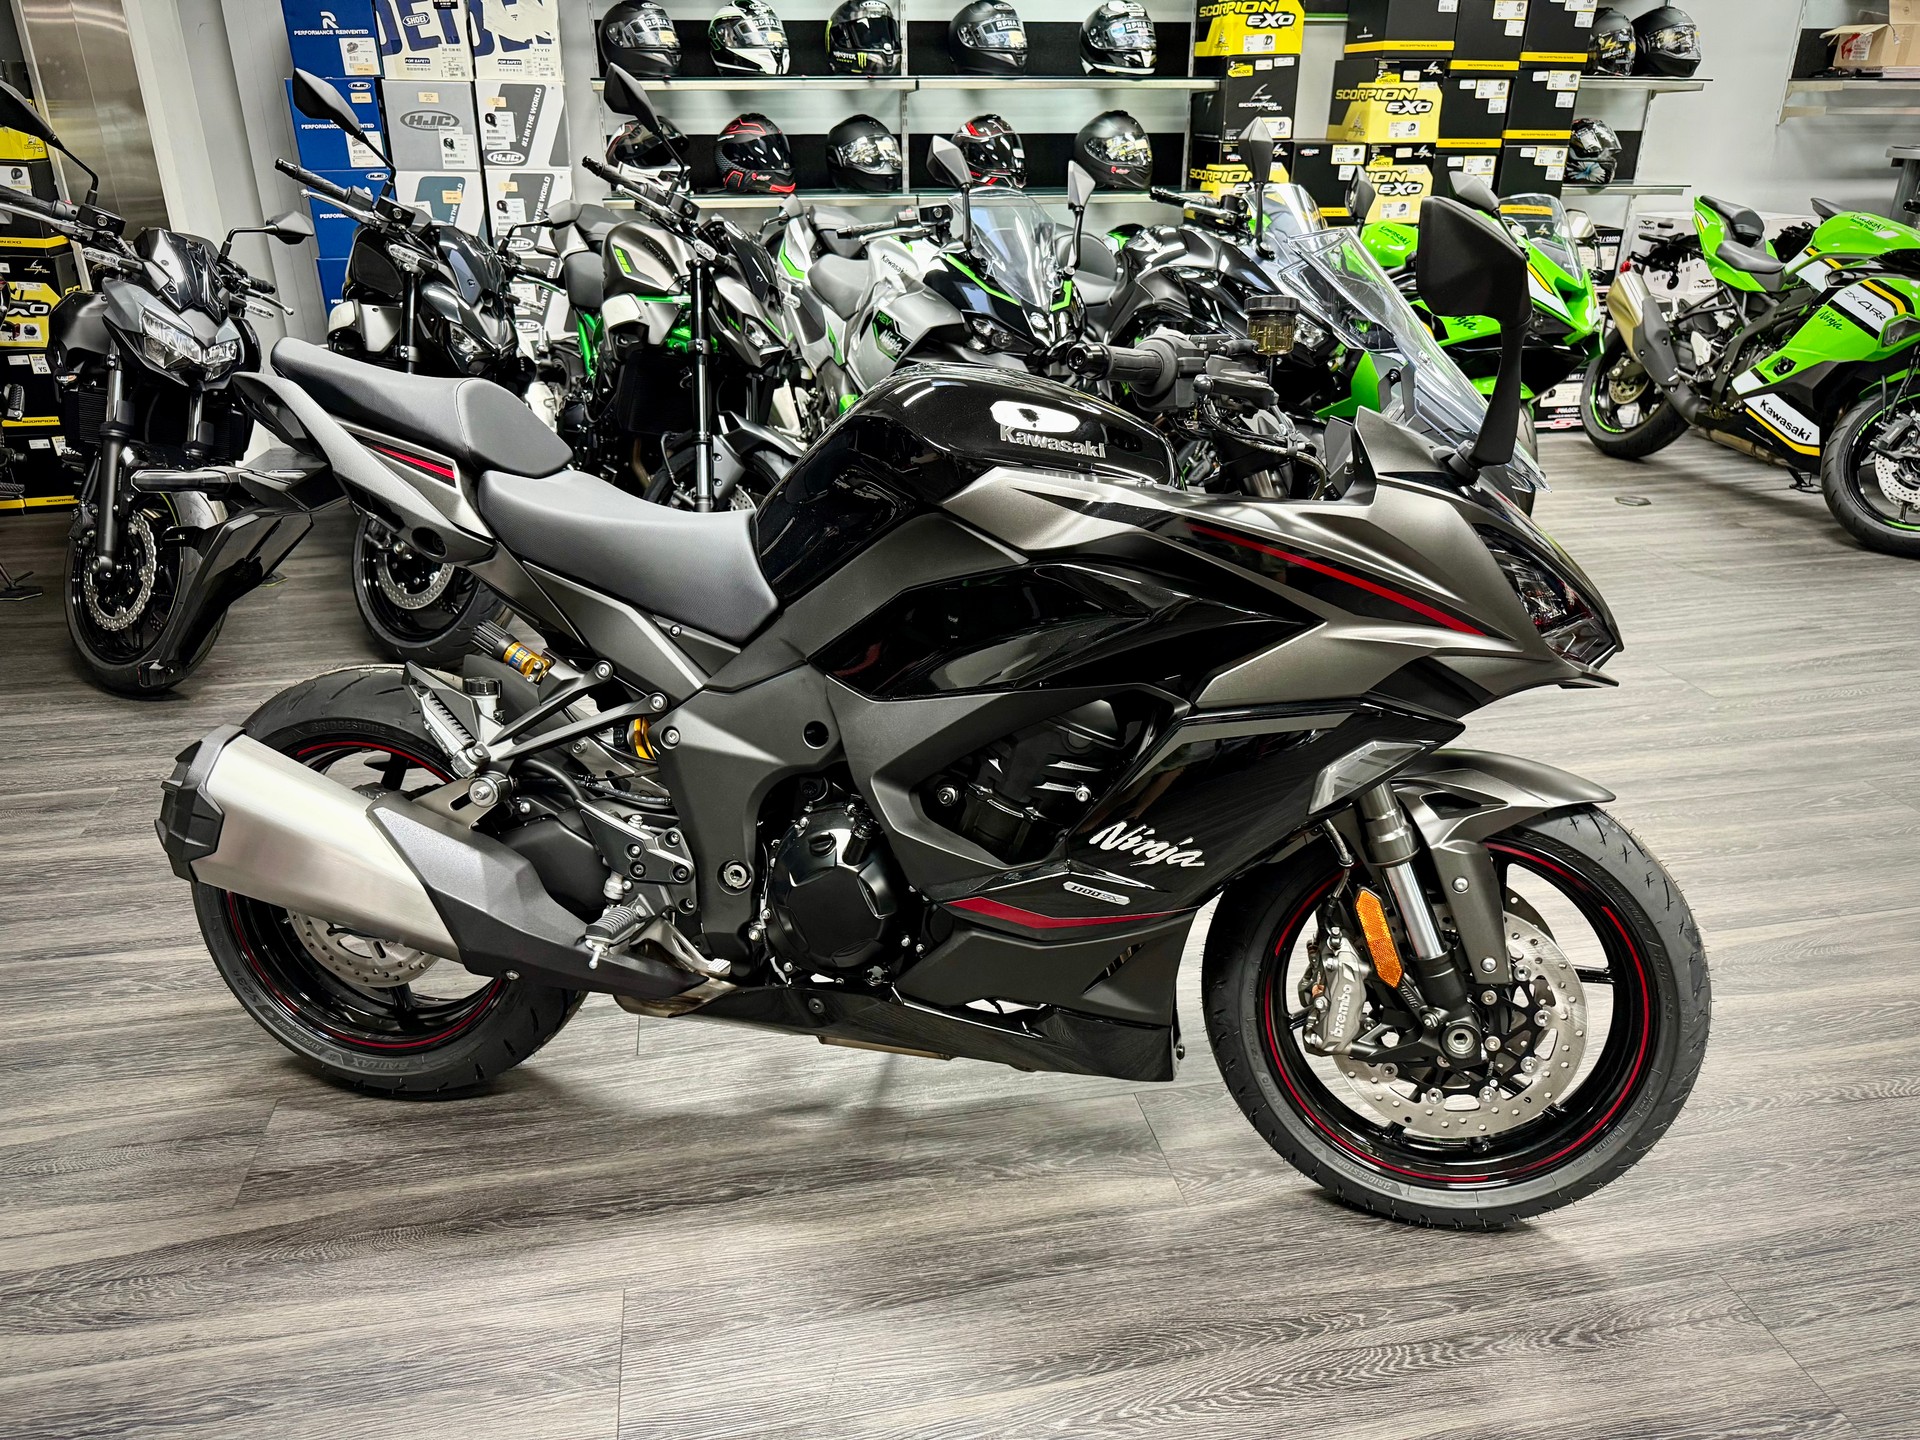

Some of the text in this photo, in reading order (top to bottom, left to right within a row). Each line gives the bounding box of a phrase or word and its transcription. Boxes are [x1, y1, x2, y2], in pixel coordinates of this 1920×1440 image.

[405, 15, 427, 25] SHOEI
[1199, 1, 1278, 18] SCORPION
[530, 87, 543, 114] WORLD
[1335, 88, 1417, 101] SCORPION
[408, 115, 452, 127] HJC
[539, 175, 551, 202] WORLD
[876, 312, 893, 326] HEV
[1818, 310, 1843, 331] Ninja
[878, 328, 903, 353] Ninja
[1760, 399, 1812, 442] Kawasaki
[1000, 423, 1107, 459] Kawasaki
[1088, 821, 1206, 868] Ninja
[1329, 984, 1353, 1038] brembo
[1333, 1156, 1393, 1190] BRIDGESTONE
